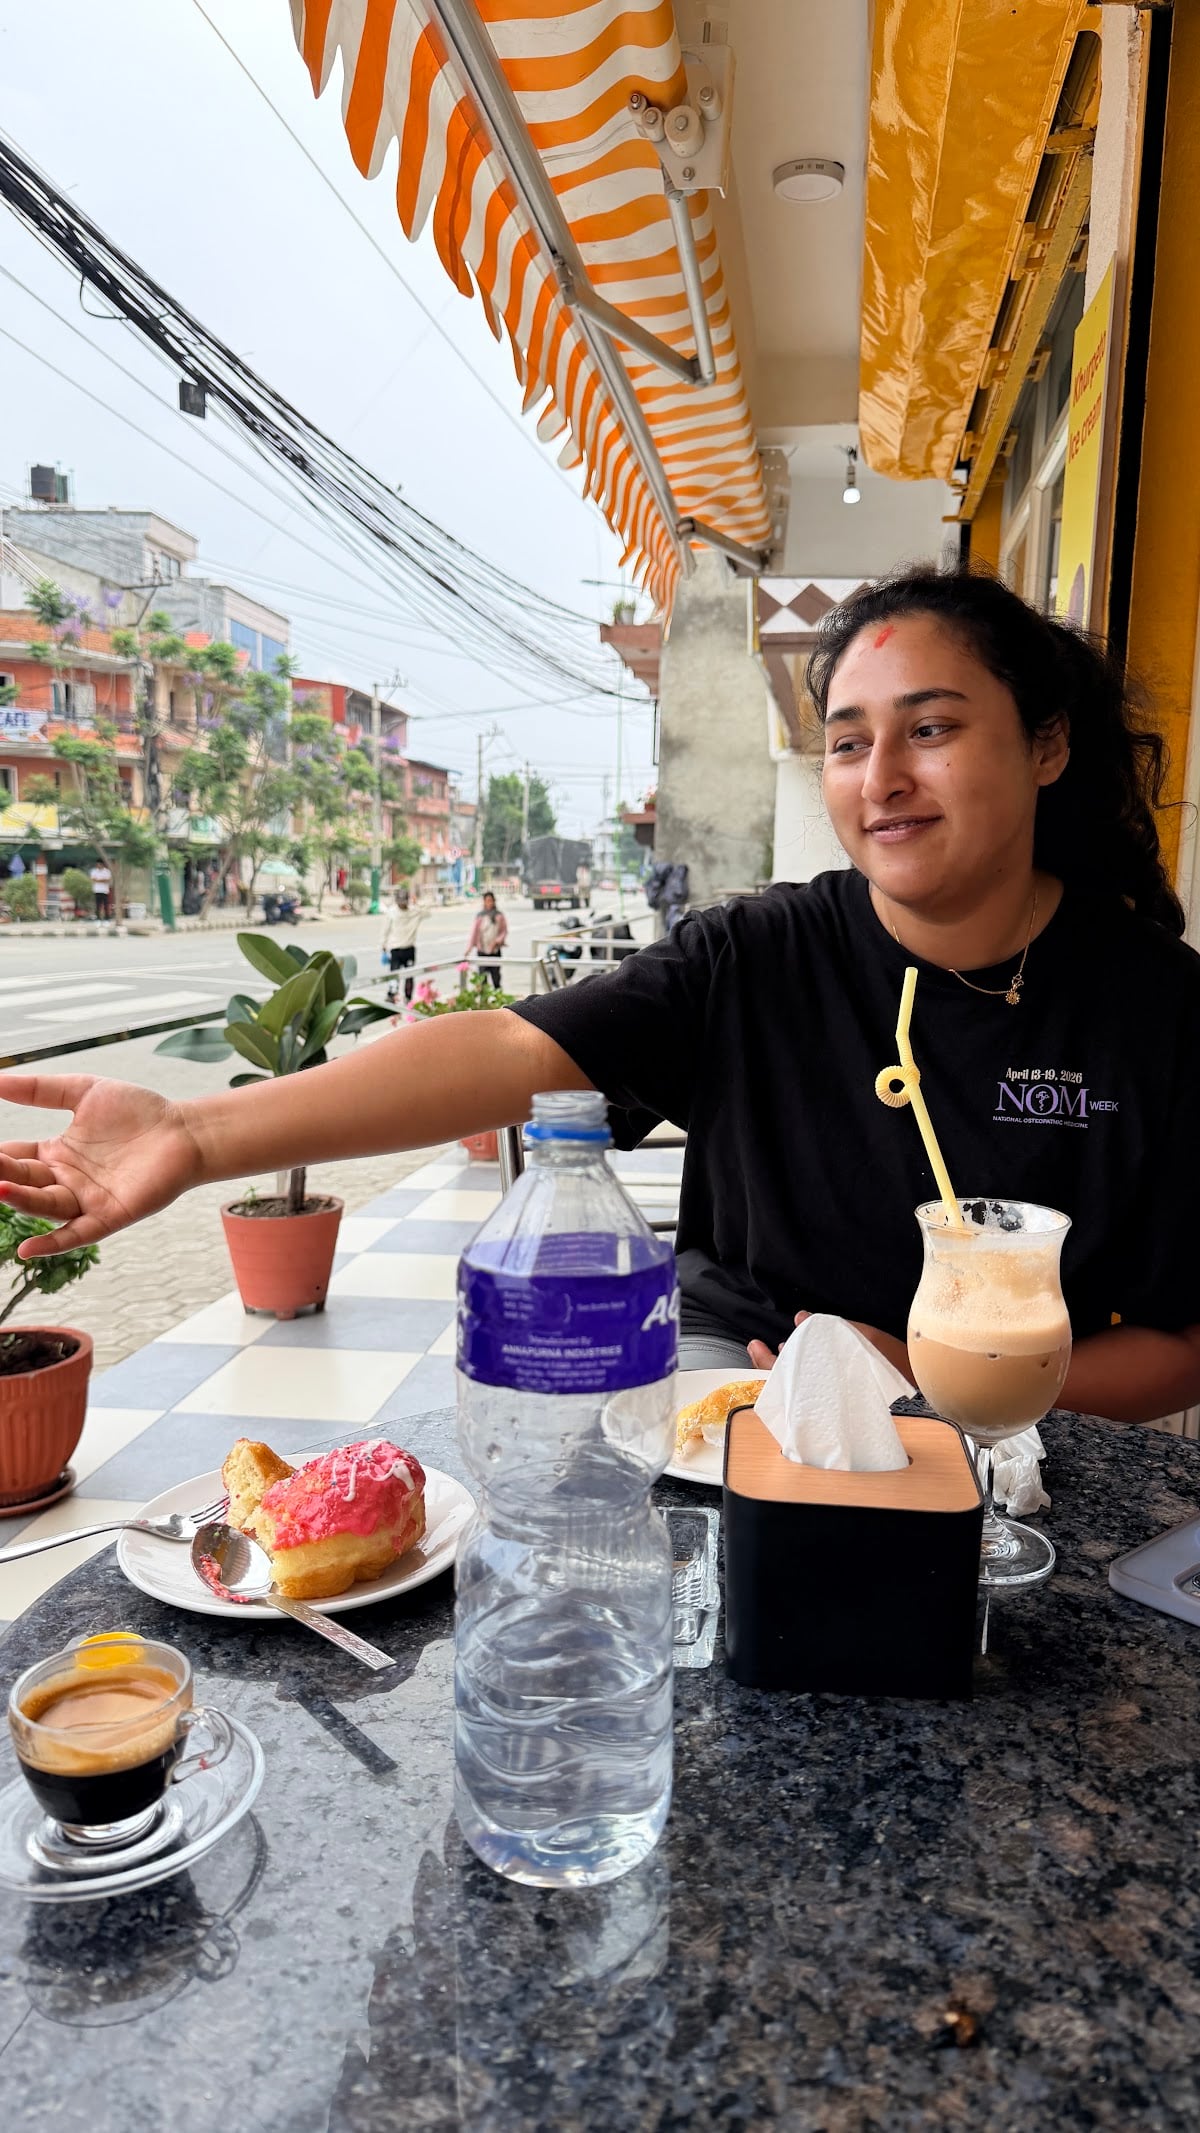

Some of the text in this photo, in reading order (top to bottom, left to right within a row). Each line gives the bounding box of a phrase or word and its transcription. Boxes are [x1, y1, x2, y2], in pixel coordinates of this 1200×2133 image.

[1069, 391, 1102, 465] Ice cream
[1005, 1067, 1083, 1084] April 13-19, 2026
[995, 1081, 1119, 1118] NOM WEEK
[992, 1115, 1022, 1123] NATIONAL
[1023, 1117, 1063, 1126] OSTEOPATHIC
[501, 1343, 623, 1359] ANNAPURNA INDUSTRIES
